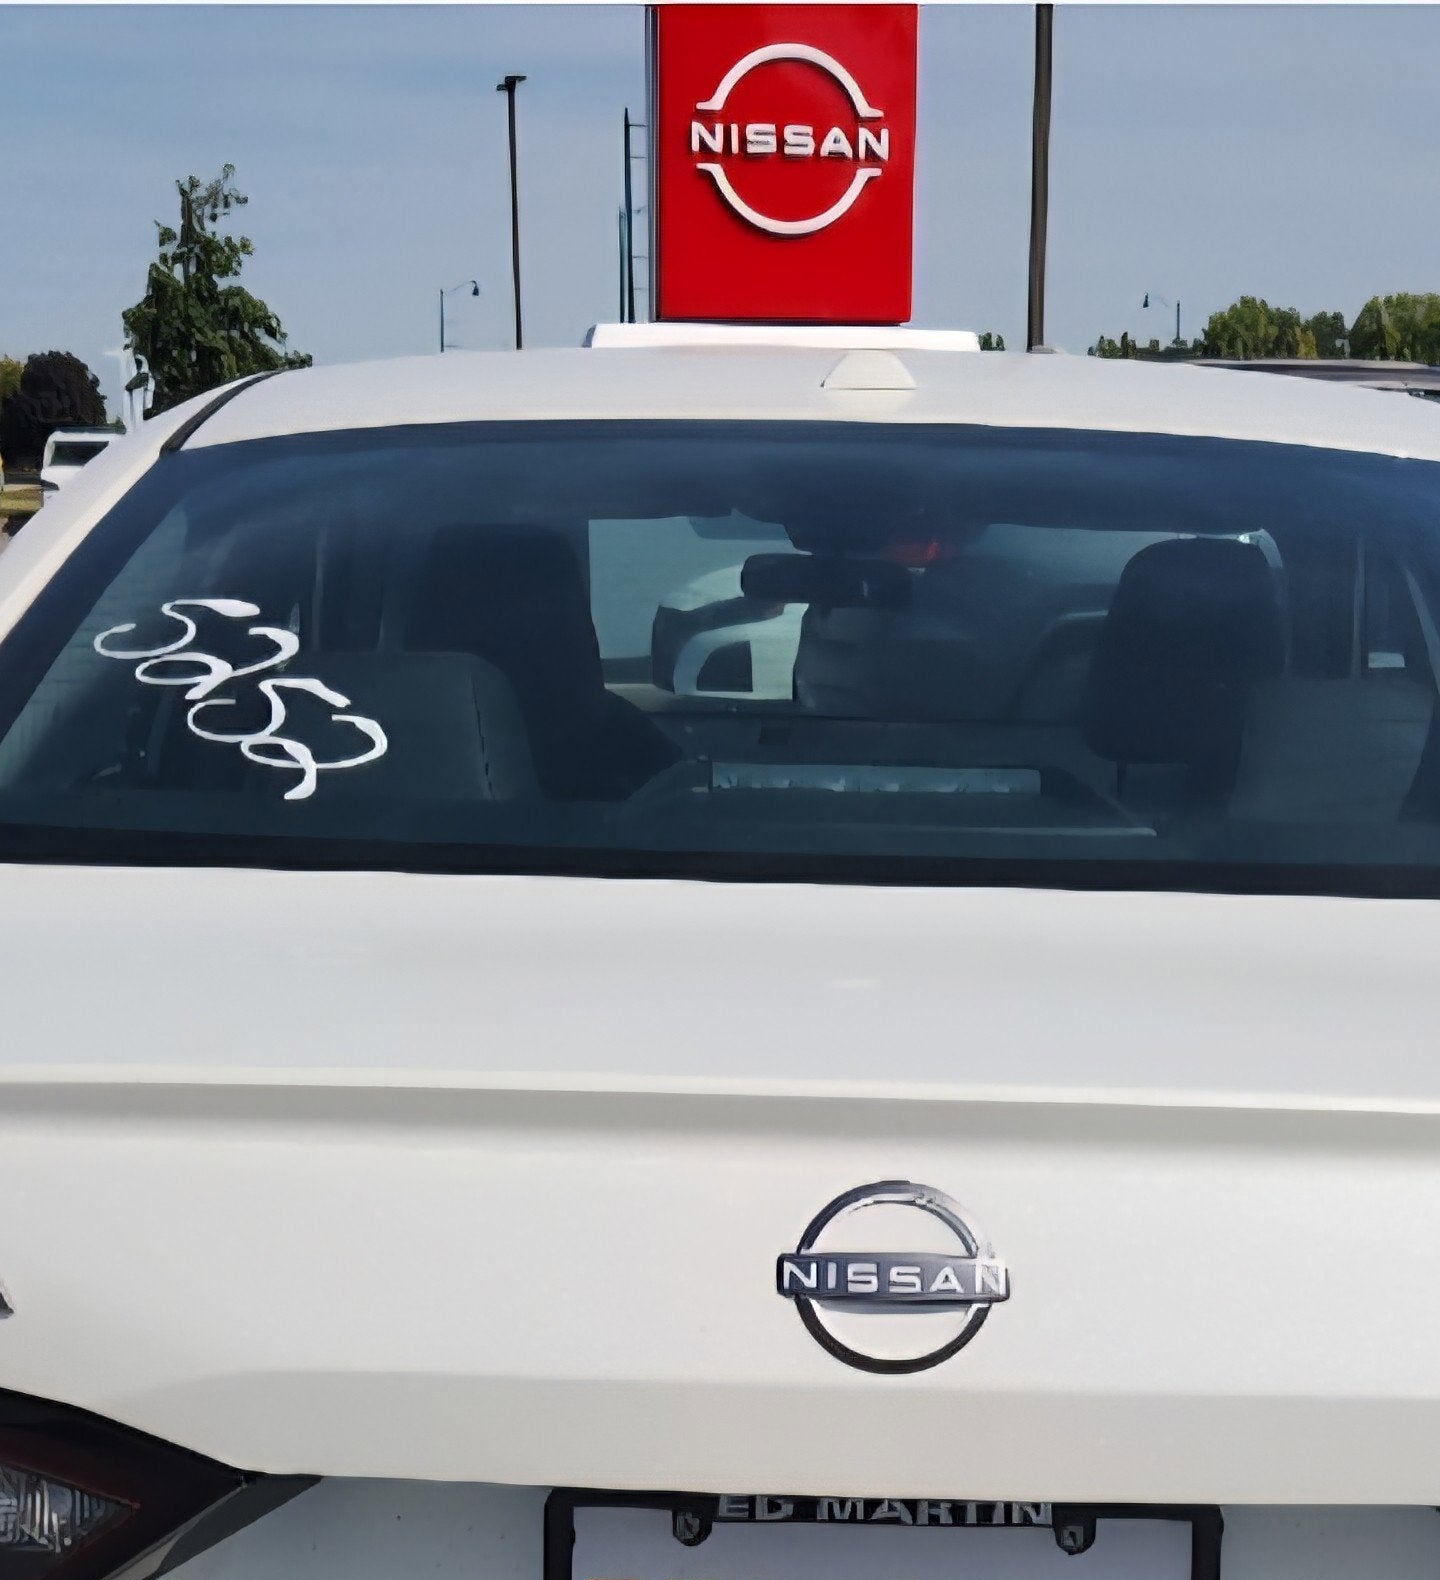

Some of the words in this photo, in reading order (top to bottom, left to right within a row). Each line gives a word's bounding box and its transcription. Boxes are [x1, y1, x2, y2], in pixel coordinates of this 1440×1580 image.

[691, 120, 889, 162] NISSAN
[783, 1259, 1007, 1295] NISSAN
[718, 1493, 794, 1520] ED
[816, 1497, 1052, 1526] MARTIN
